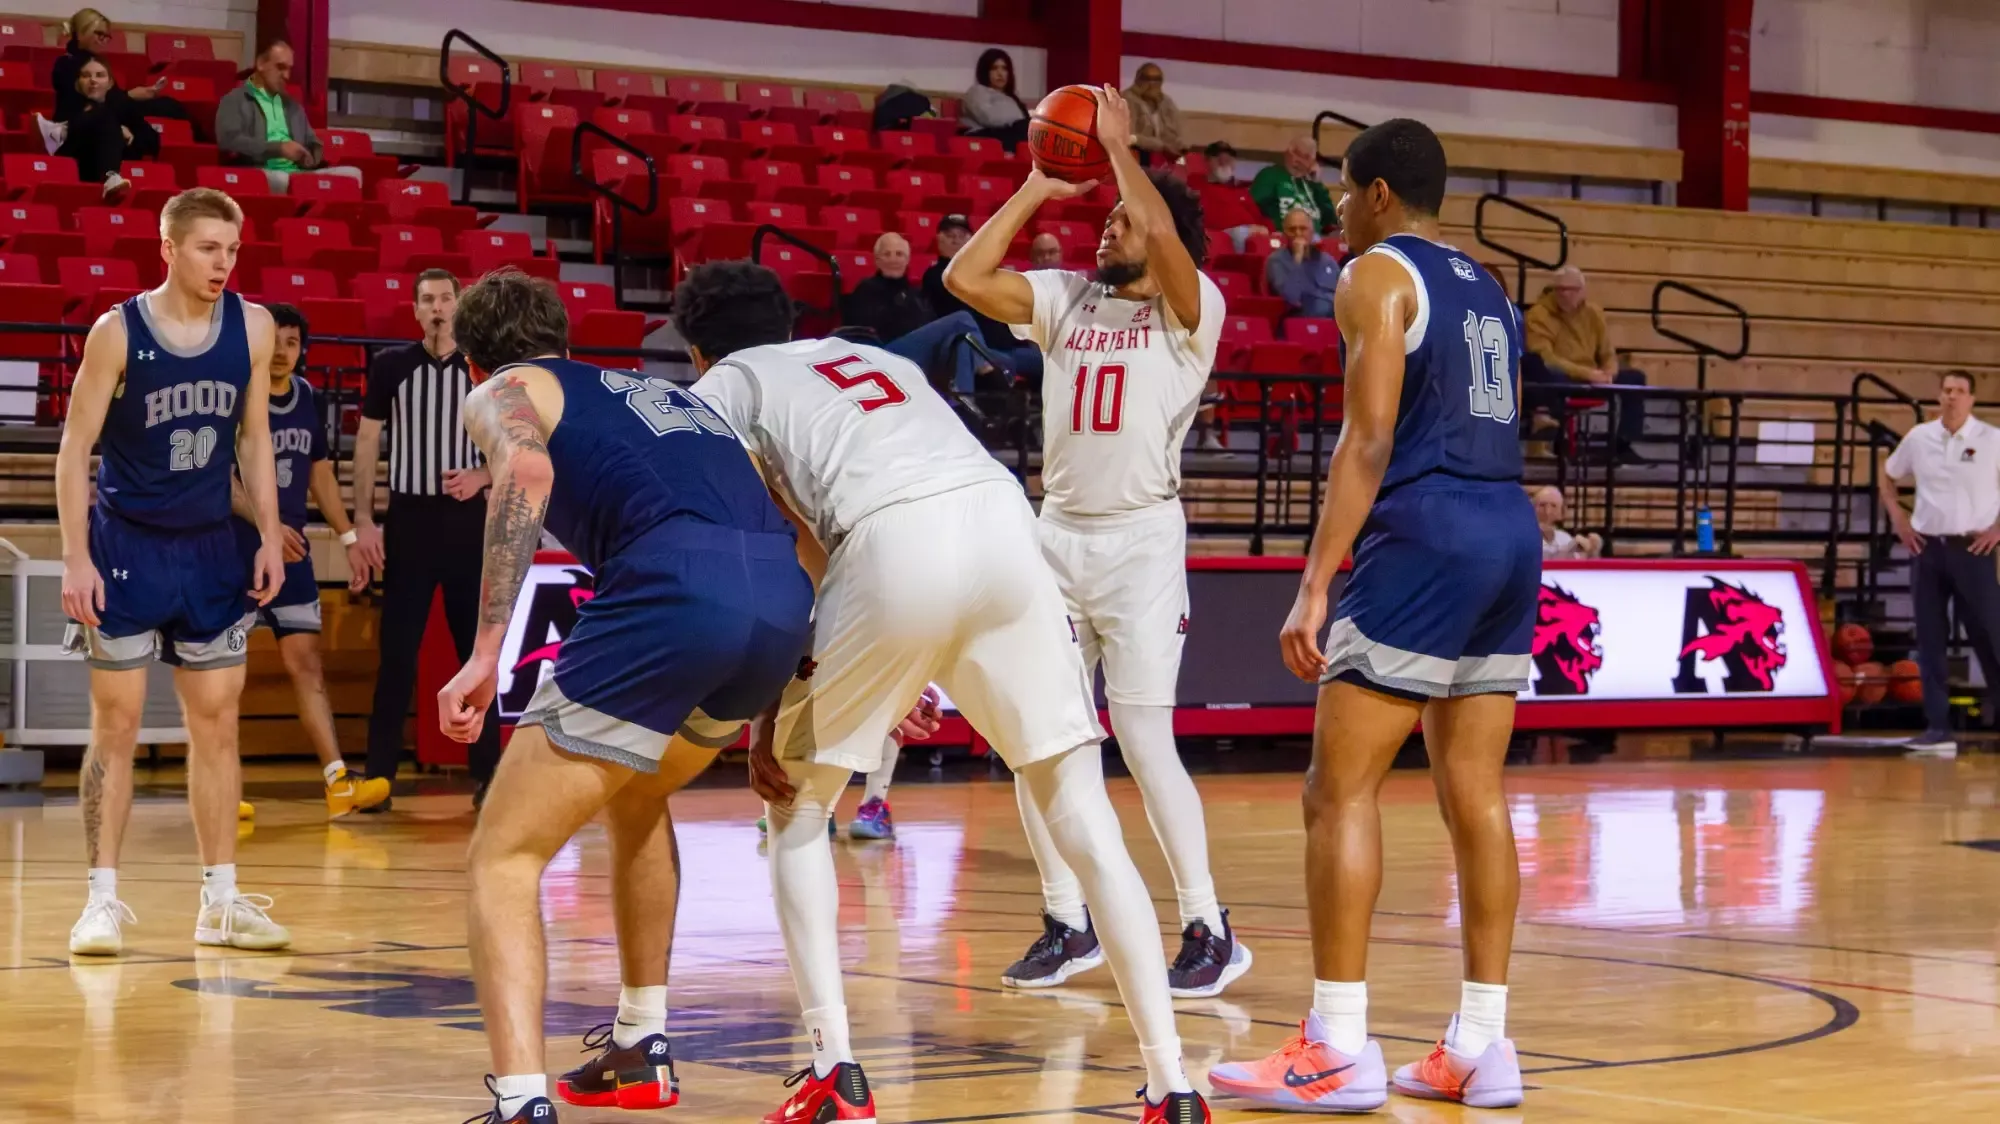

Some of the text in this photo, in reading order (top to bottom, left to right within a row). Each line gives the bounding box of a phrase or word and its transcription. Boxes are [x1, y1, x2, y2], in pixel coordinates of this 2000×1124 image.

[1064, 325, 1151, 352] ALBRIGHT
[806, 352, 911, 414] 5
[1463, 309, 1516, 424] 13
[145, 380, 237, 428] HOOD
[1070, 361, 1128, 435] 10
[169, 426, 217, 471] 20
[270, 428, 312, 455] OOD
